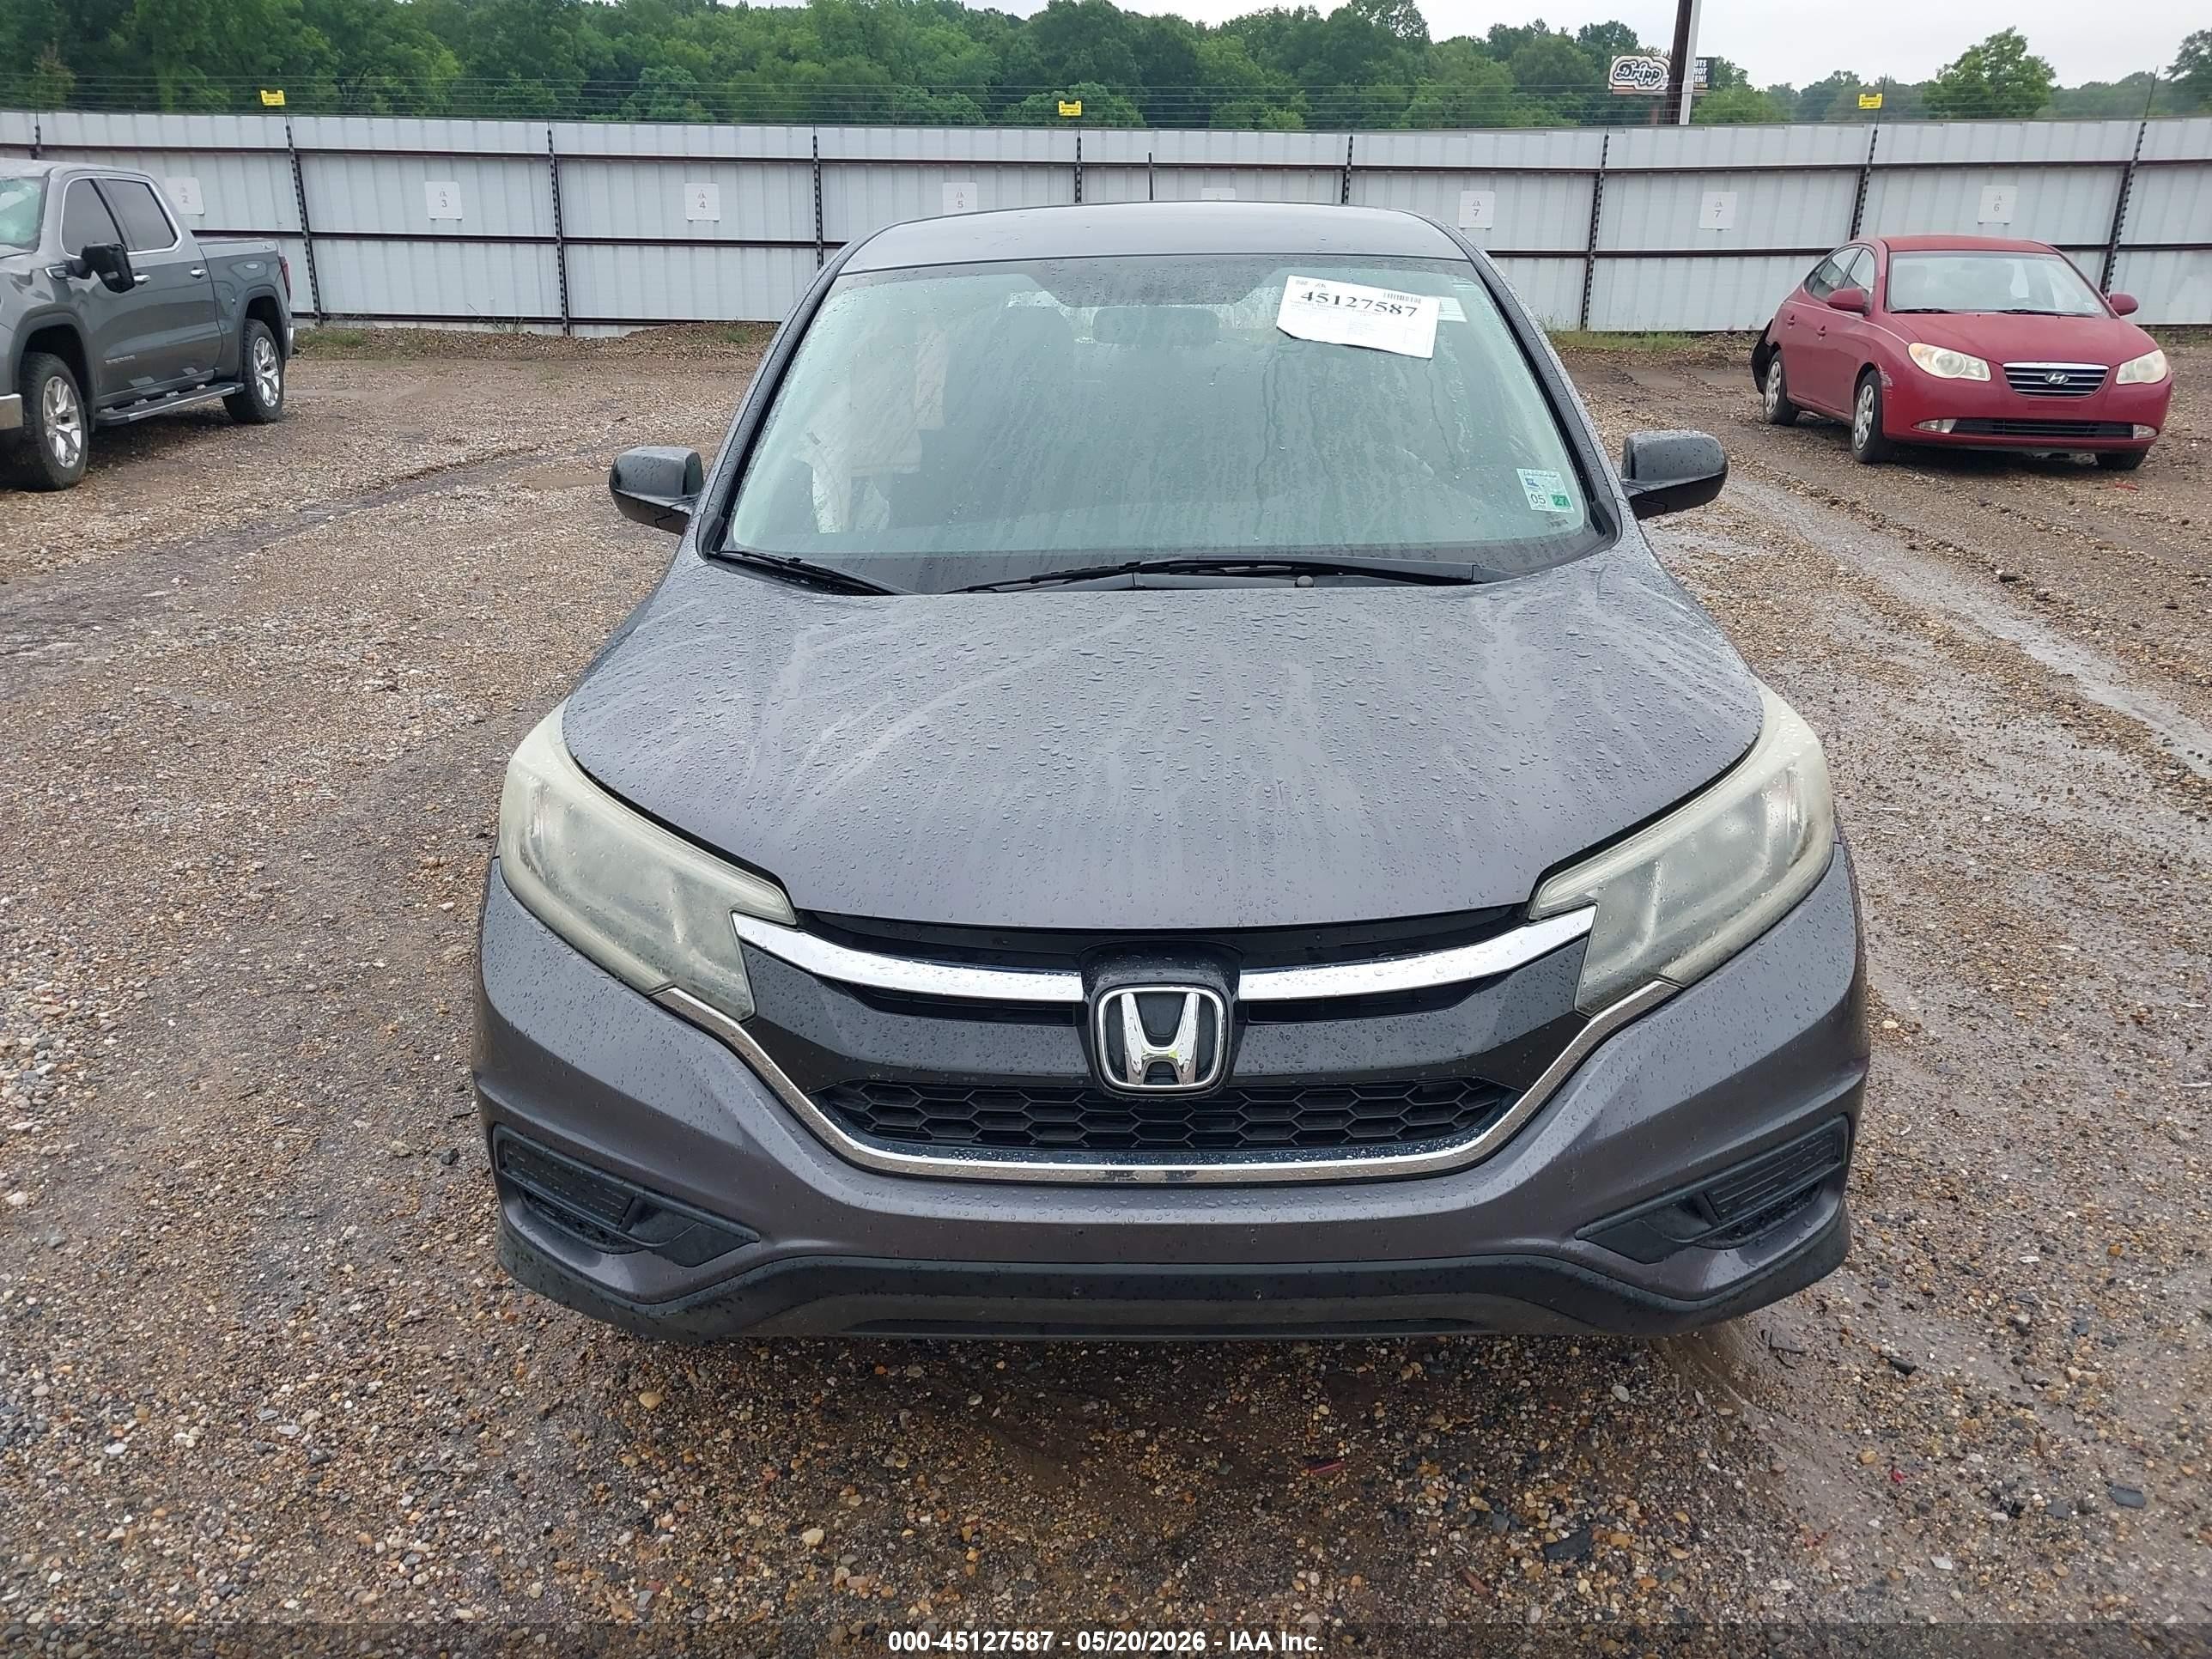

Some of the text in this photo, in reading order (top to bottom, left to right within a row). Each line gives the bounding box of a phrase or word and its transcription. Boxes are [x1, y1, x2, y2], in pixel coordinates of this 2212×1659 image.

[1615, 62, 1662, 84] Dripp
[441, 199, 447, 208] 3
[699, 201, 706, 210] 4
[957, 200, 963, 209] 5
[1300, 291, 1418, 317] 45127587
[1531, 494, 1546, 504] 05
